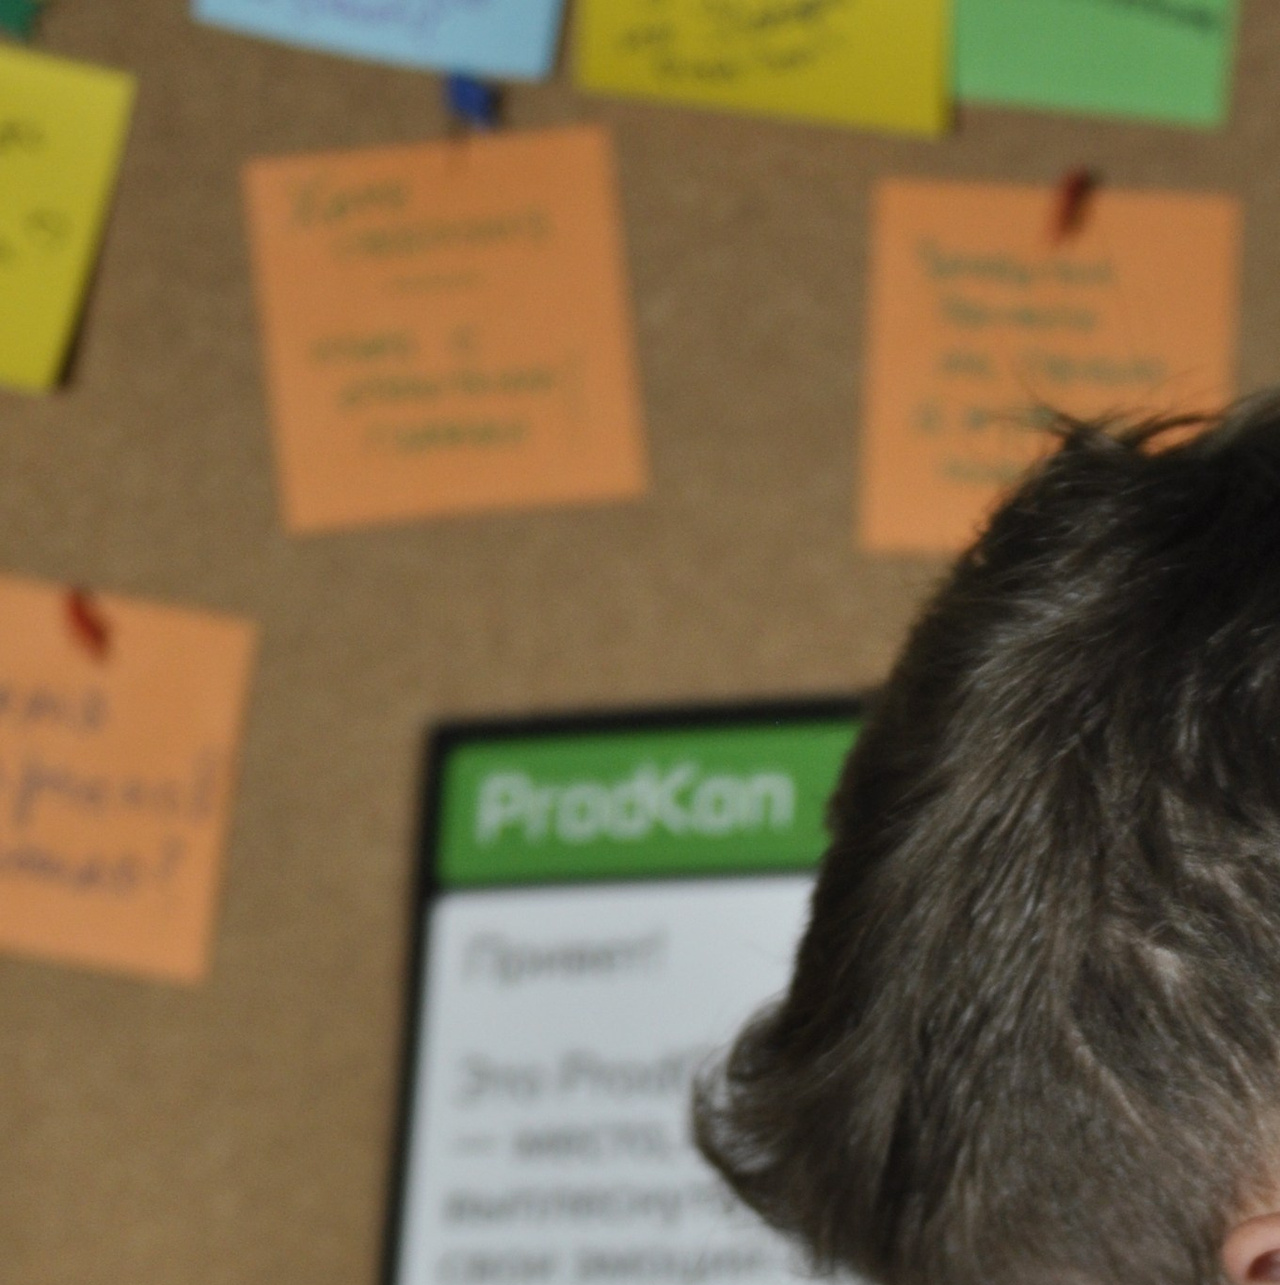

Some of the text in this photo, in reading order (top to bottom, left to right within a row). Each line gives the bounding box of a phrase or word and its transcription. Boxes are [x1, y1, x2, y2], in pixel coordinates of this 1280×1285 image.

[474, 762, 795, 847] ProdKon
[459, 1049, 700, 1102] Это Prod
[446, 1181, 740, 1231] выплеснут
